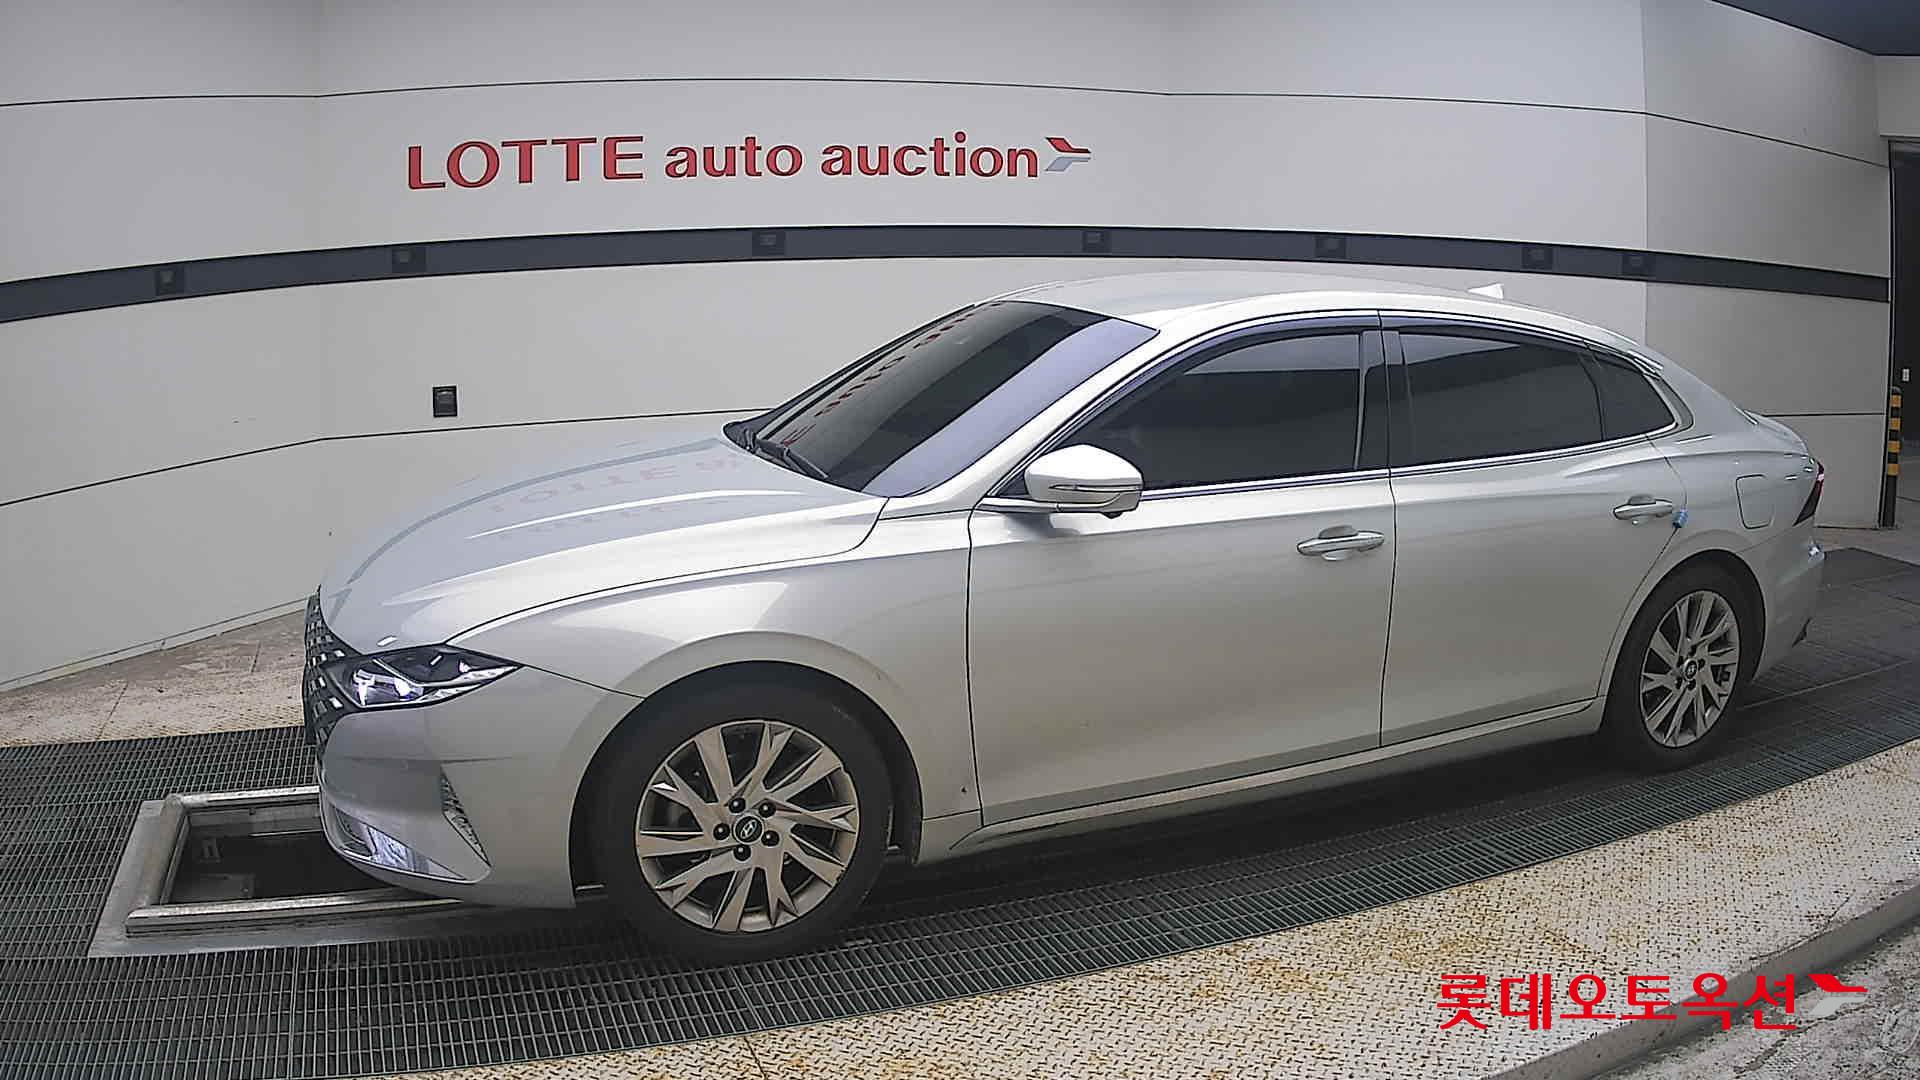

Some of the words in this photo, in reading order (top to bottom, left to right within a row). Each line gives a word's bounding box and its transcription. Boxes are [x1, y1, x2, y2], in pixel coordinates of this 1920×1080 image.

[408, 135, 645, 190] LOTTE
[665, 136, 803, 178] auto
[820, 131, 1039, 178] auction
